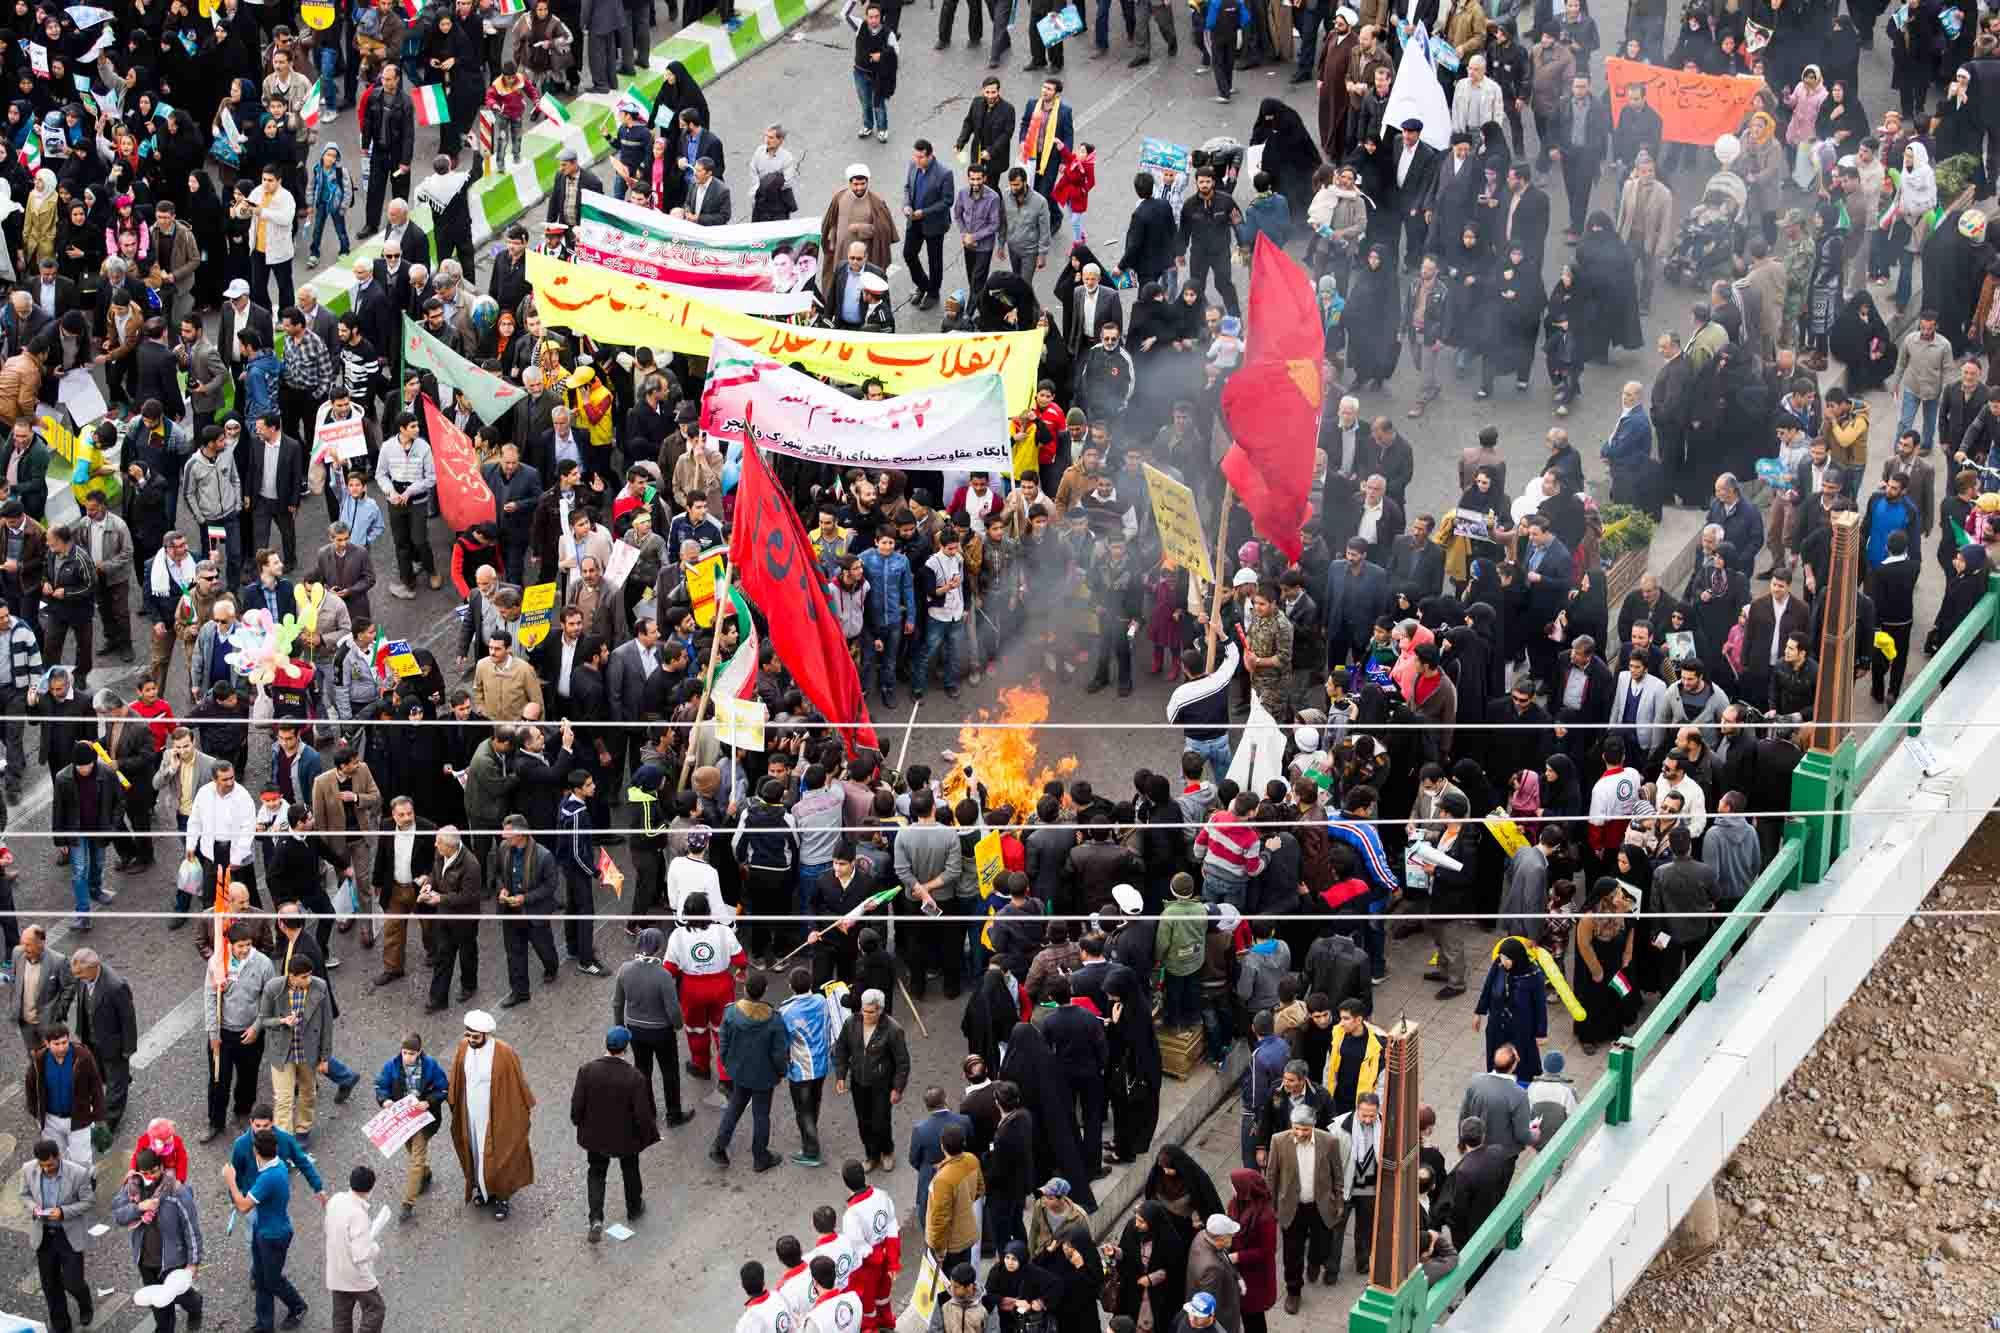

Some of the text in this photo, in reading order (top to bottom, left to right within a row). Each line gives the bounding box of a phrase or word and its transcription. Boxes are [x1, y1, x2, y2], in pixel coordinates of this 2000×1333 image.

[867, 334, 1011, 379] انقلاب
[765, 431, 804, 452] شهرک
[804, 443, 844, 463] والفجر
[845, 450, 890, 463] شهدای
[891, 455, 924, 465] بسیج
[925, 449, 974, 463] مقاومت
